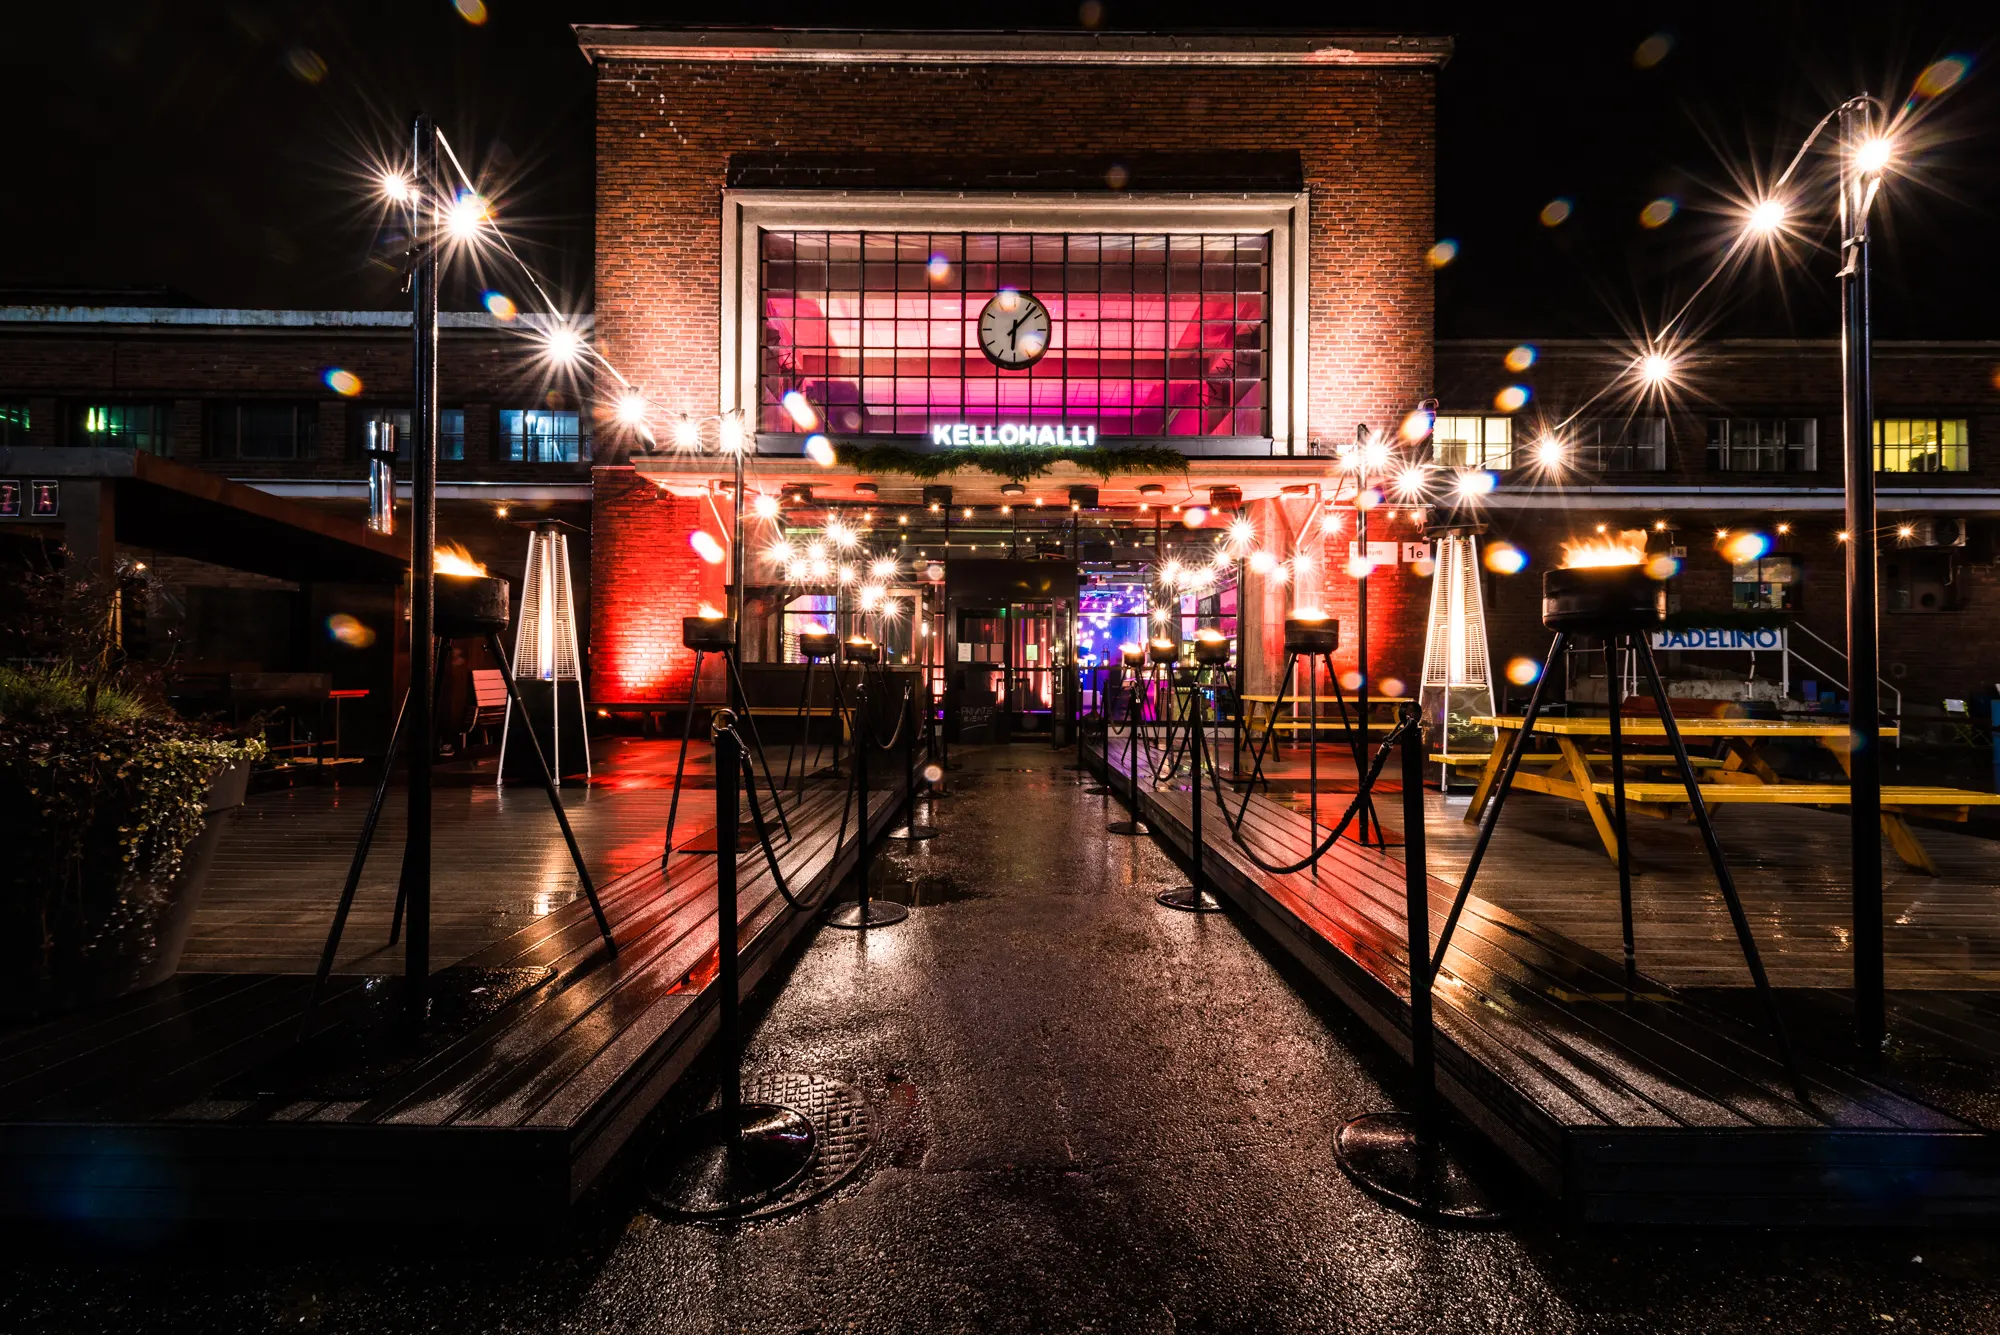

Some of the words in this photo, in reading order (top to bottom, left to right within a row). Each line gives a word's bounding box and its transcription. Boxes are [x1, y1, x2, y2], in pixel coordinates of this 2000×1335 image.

[933, 424, 1096, 446] KELLOHALLI
[1409, 545, 1424, 559] 1e
[1659, 628, 1777, 648] JADELINO
[961, 706, 993, 715] PRIVATE
